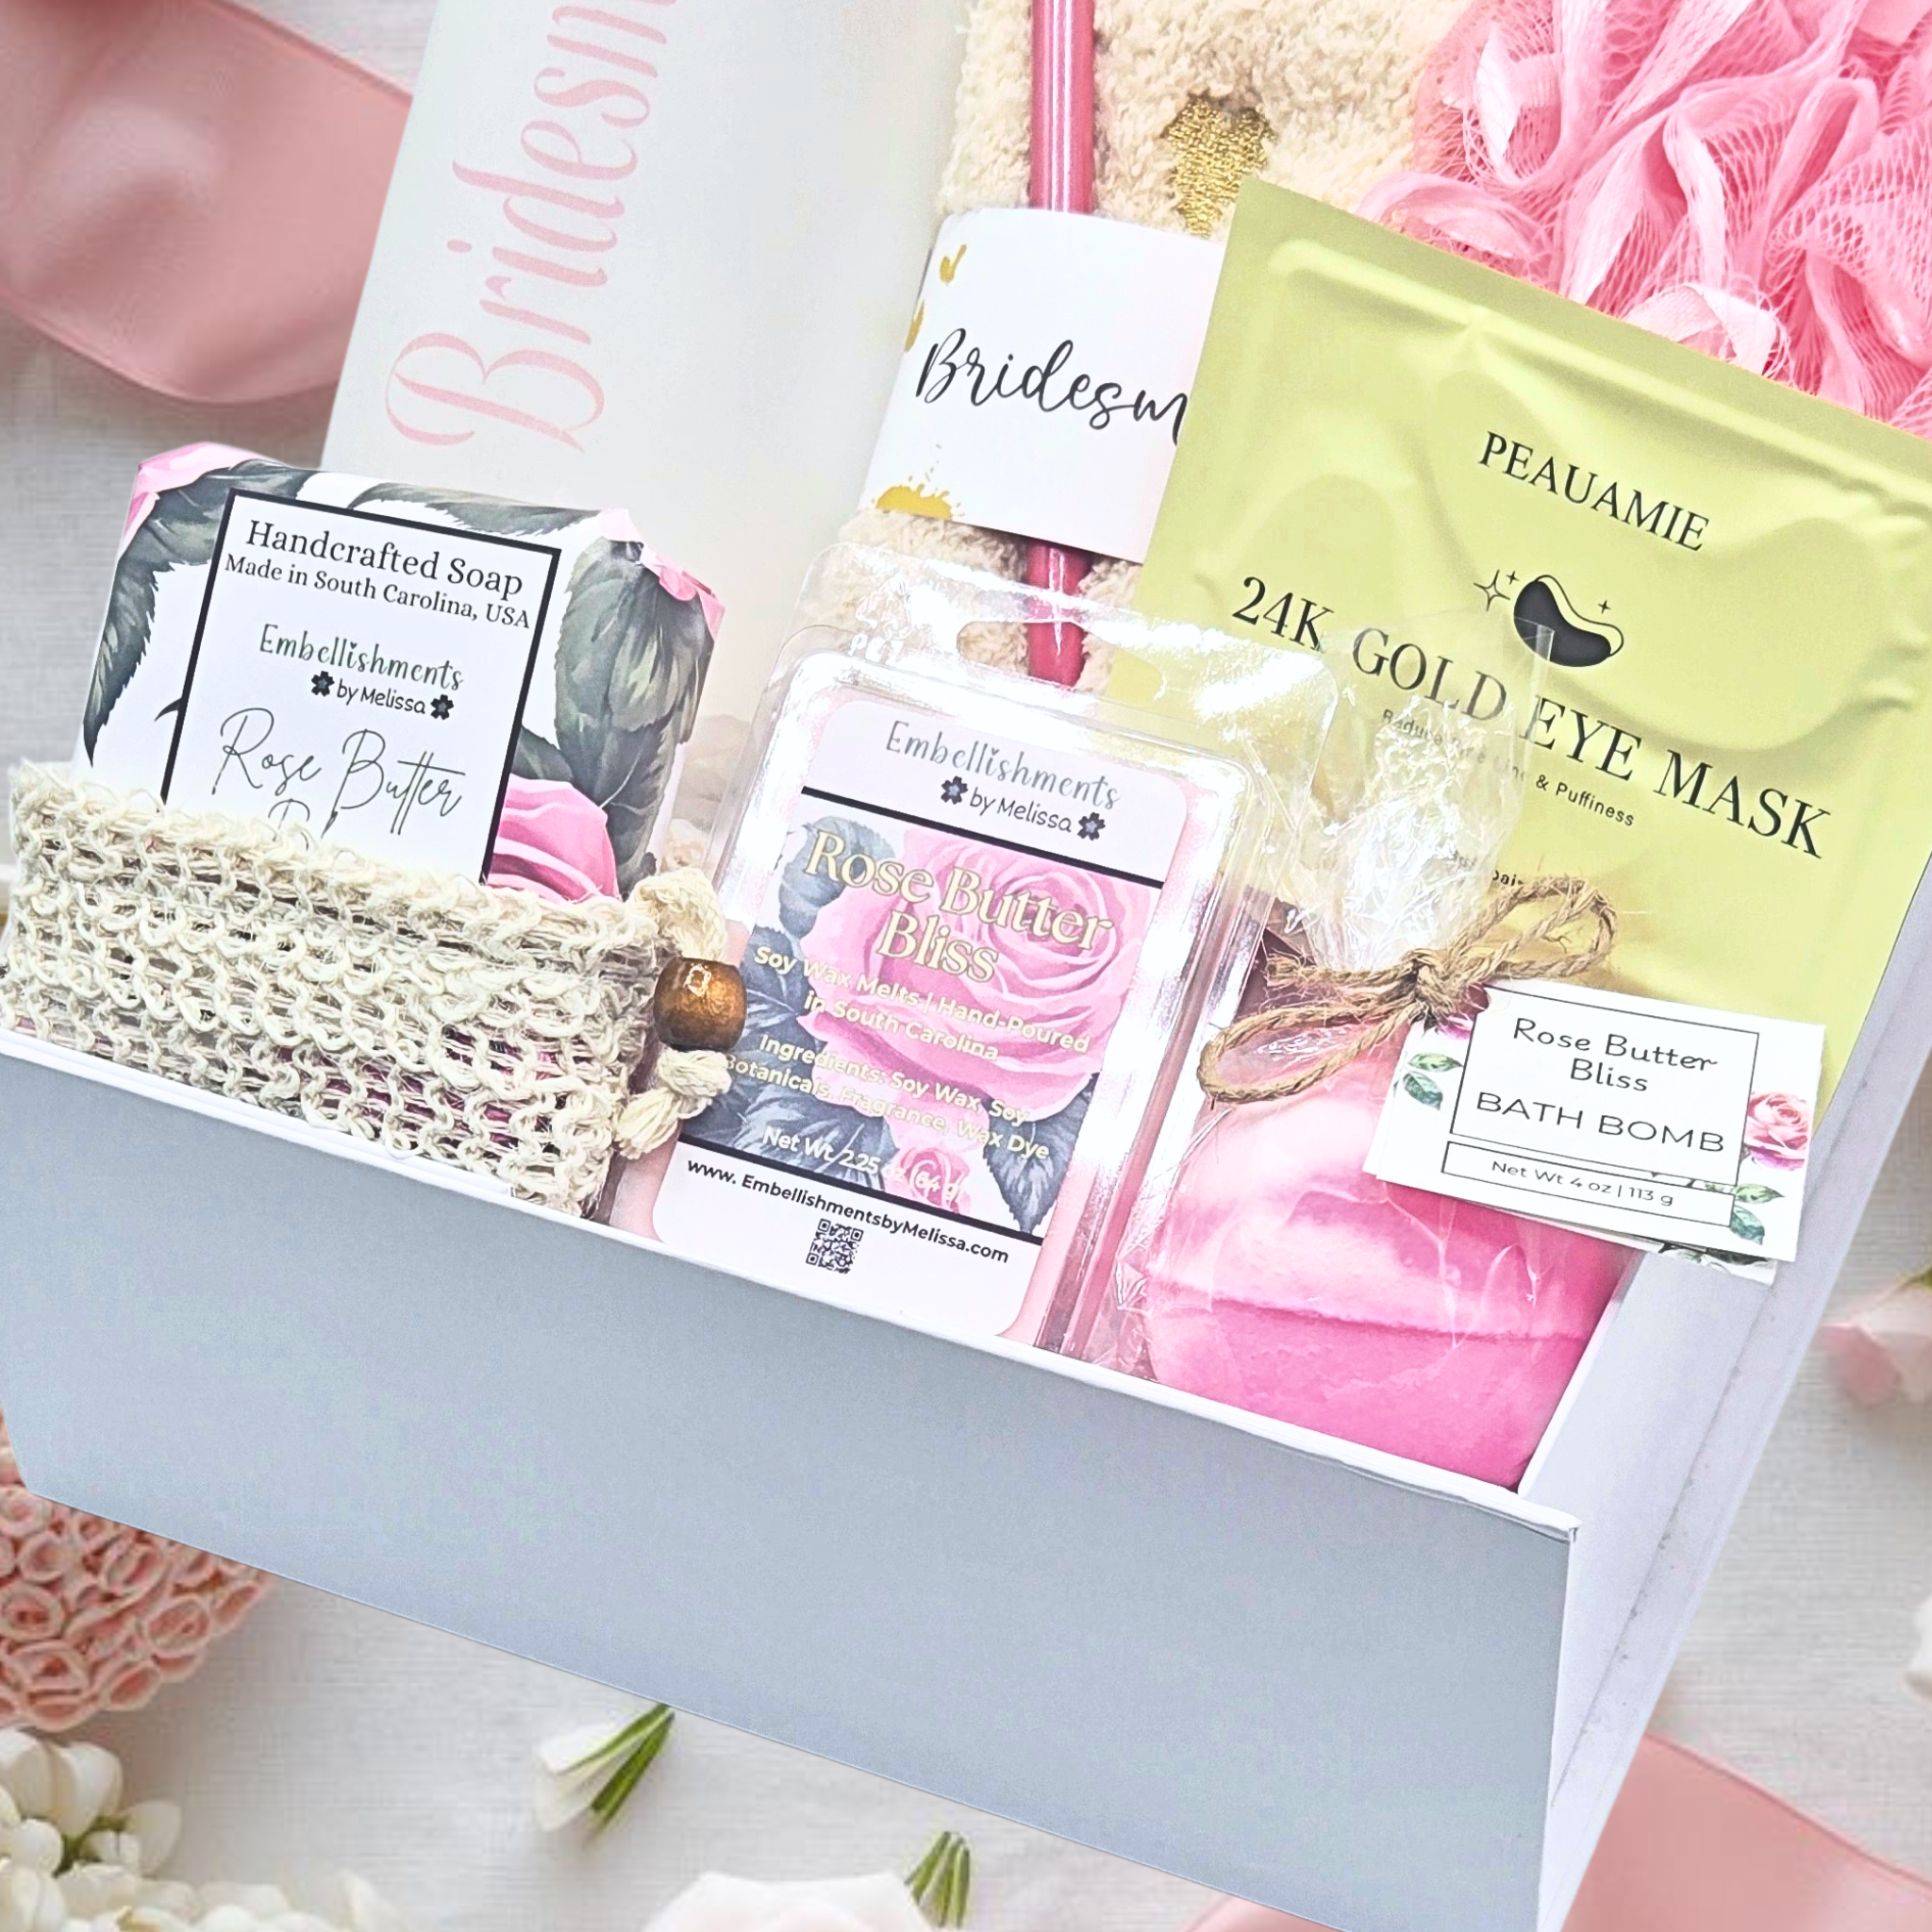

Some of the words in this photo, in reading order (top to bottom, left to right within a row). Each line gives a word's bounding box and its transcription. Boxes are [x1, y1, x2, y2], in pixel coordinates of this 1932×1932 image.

[915, 327, 1189, 446] Bridesm
[1477, 430, 1709, 553] PEAUAMIE
[225, 554, 283, 581] Made
[288, 564, 308, 587] in
[314, 571, 376, 600] South
[383, 584, 478, 621] Carolina,
[486, 604, 530, 629] USA
[245, 519, 440, 580] Handcrafted
[448, 558, 524, 601] Soap
[259, 624, 464, 691] Embellishments
[337, 678, 358, 707] by
[360, 688, 425, 715] Melissa
[1232, 575, 1334, 652] 24K
[1352, 625, 1508, 724] GOLD
[1520, 693, 1641, 781] EYE
[1653, 748, 1830, 858] MASK
[212, 708, 322, 795] Rose
[321, 729, 466, 839] Butter
[886, 720, 1121, 810] Embellishments
[1535, 774, 1549, 791] &
[1556, 781, 1635, 827] Puffiness
[970, 787, 995, 816] by
[996, 797, 1072, 833] Melissa
[804, 829, 935, 904] Rose
[941, 866, 1113, 952] Butter
[875, 909, 1000, 983] Bliss
[754, 945, 798, 974] Soy
[803, 958, 850, 987] Wax
[856, 974, 920, 1007] Melts
[937, 996, 1091, 1054] Hand-Poured
[804, 990, 825, 1013] in
[833, 1000, 901, 1034] South
[906, 1021, 1000, 1061] Carolina
[759, 1034, 887, 1085] Ingredients:
[891, 1072, 929, 1098] Soy
[935, 1081, 984, 1114] Wax,
[989, 1099, 1030, 1127] Soy
[1513, 1017, 1591, 1053] Rose
[1605, 1033, 1718, 1073] Butter
[1571, 1058, 1649, 1092] Bliss
[762, 1125, 800, 1152] Net
[839, 1086, 949, 1135] Fragrance,
[958, 1120, 1005, 1148] Wax
[1007, 1135, 1050, 1159] Dye
[1477, 1091, 1584, 1131] BATH
[1598, 1114, 1726, 1154] BOMB
[687, 1158, 736, 1185] www.
[741, 1174, 1009, 1265] EmbellishmentsbyMelissa.com
[1492, 1160, 1527, 1178] Net
[1534, 1169, 1566, 1186] Wt
[1570, 1173, 1584, 1188] 4
[1588, 1181, 1613, 1194] oz
[1628, 1185, 1655, 1202] 113
[1659, 1193, 1674, 1208] g
